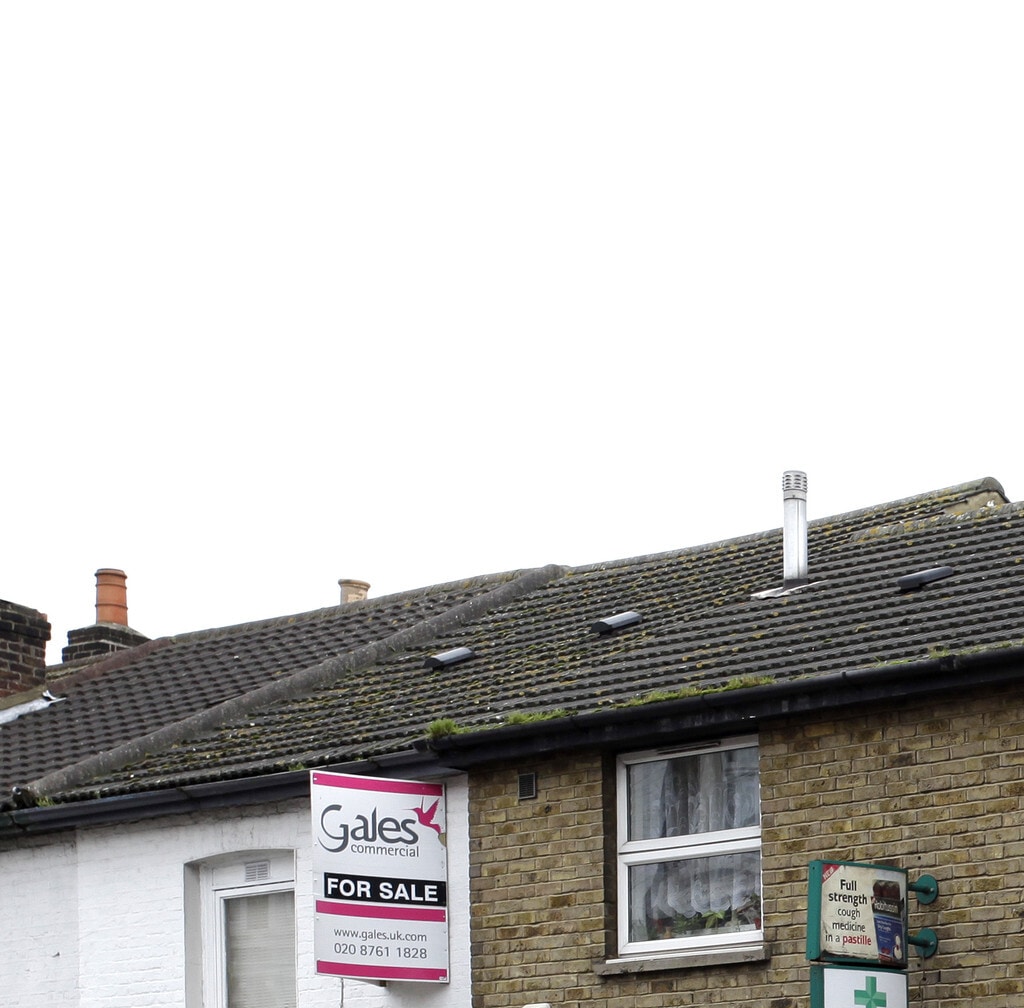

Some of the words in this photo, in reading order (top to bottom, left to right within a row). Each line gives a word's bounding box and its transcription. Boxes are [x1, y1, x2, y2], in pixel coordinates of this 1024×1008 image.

[318, 803, 419, 853] Gales
[350, 843, 420, 857] commercial
[327, 878, 371, 898] FOR
[379, 882, 438, 902] SALE
[840, 879, 857, 891] Full
[828, 892, 868, 907] strength
[837, 908, 860, 920] cough
[832, 921, 866, 932] medicine
[333, 927, 428, 943] www.gales.uk.com
[825, 934, 833, 942] in
[843, 935, 872, 946] pastille
[334, 942, 357, 955] 020
[360, 945, 390, 957] 8761
[396, 946, 427, 959] 1828
